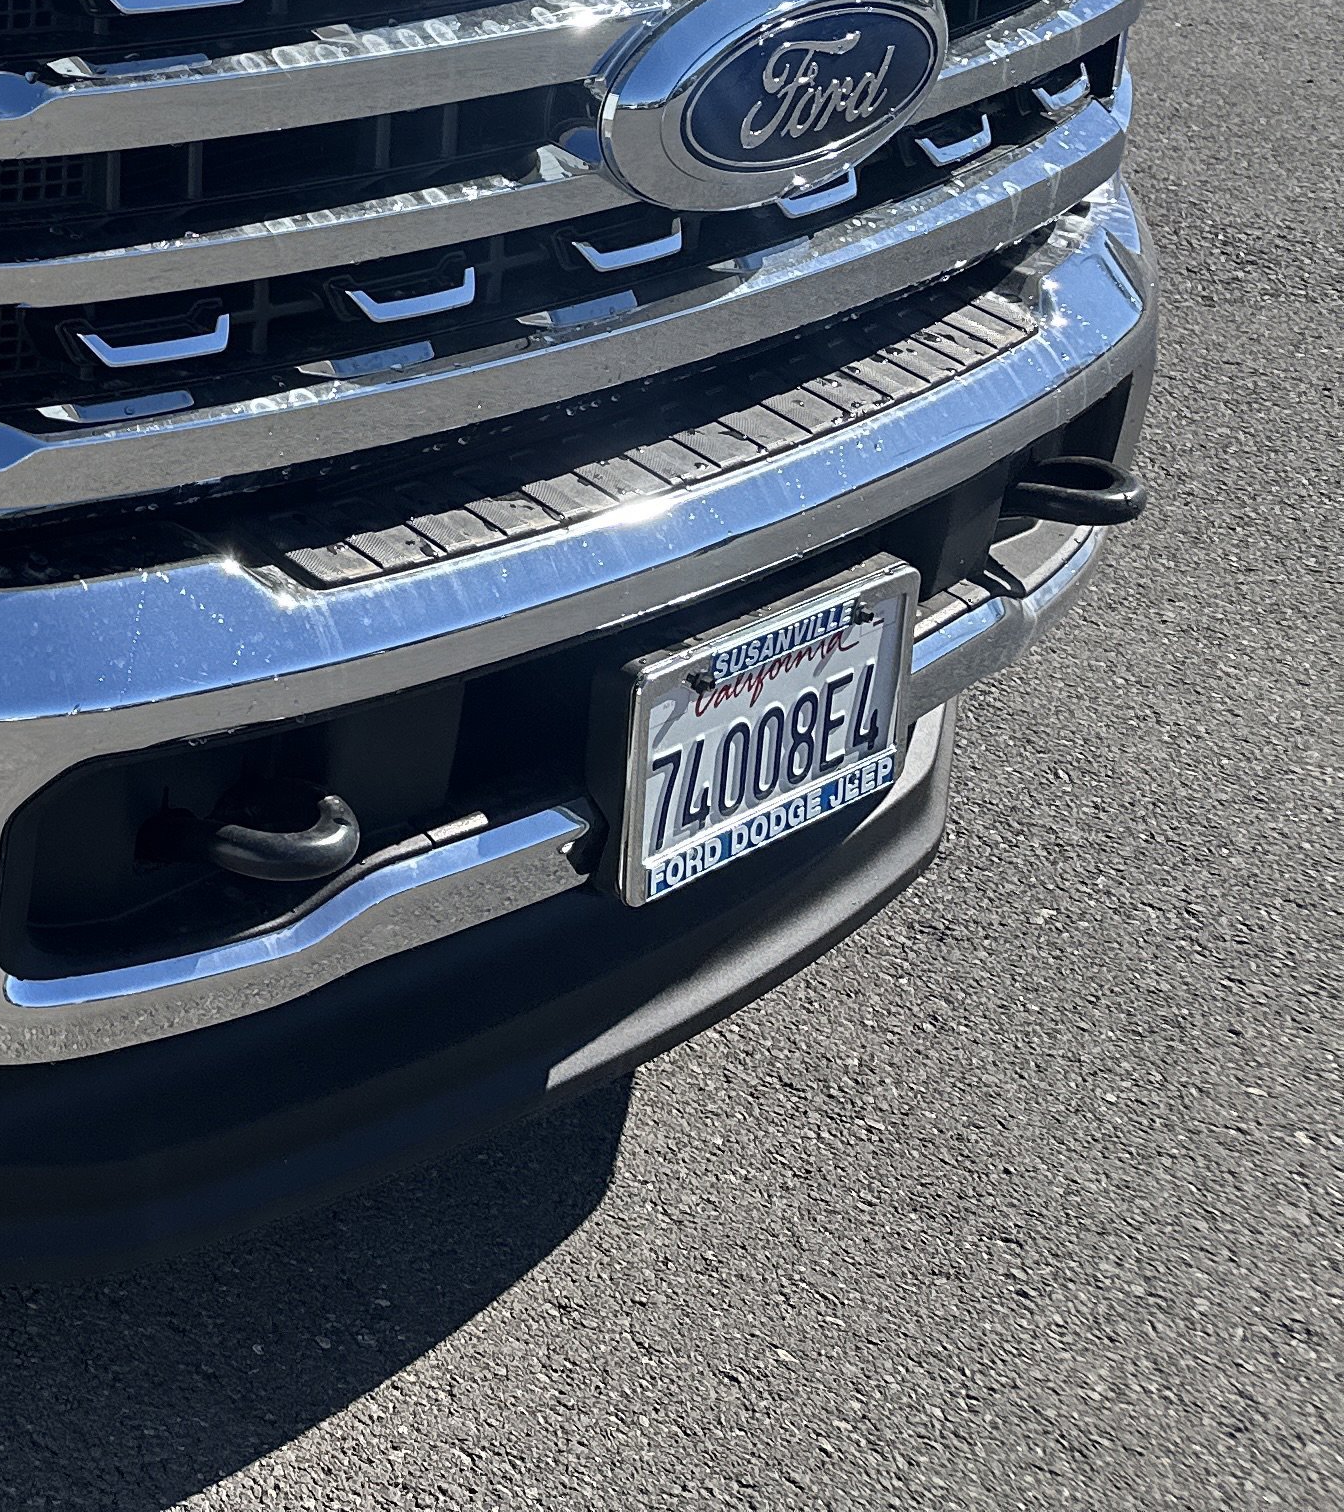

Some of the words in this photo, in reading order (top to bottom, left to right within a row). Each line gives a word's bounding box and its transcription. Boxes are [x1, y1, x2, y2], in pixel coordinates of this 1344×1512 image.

[740, 30, 896, 149] Ford
[695, 630, 859, 717] California
[714, 600, 855, 679] SUSANVILLE
[652, 662, 880, 850] 74008E4
[650, 838, 723, 896] FORD
[731, 788, 822, 856] DODGE
[829, 756, 893, 808] JEEP
